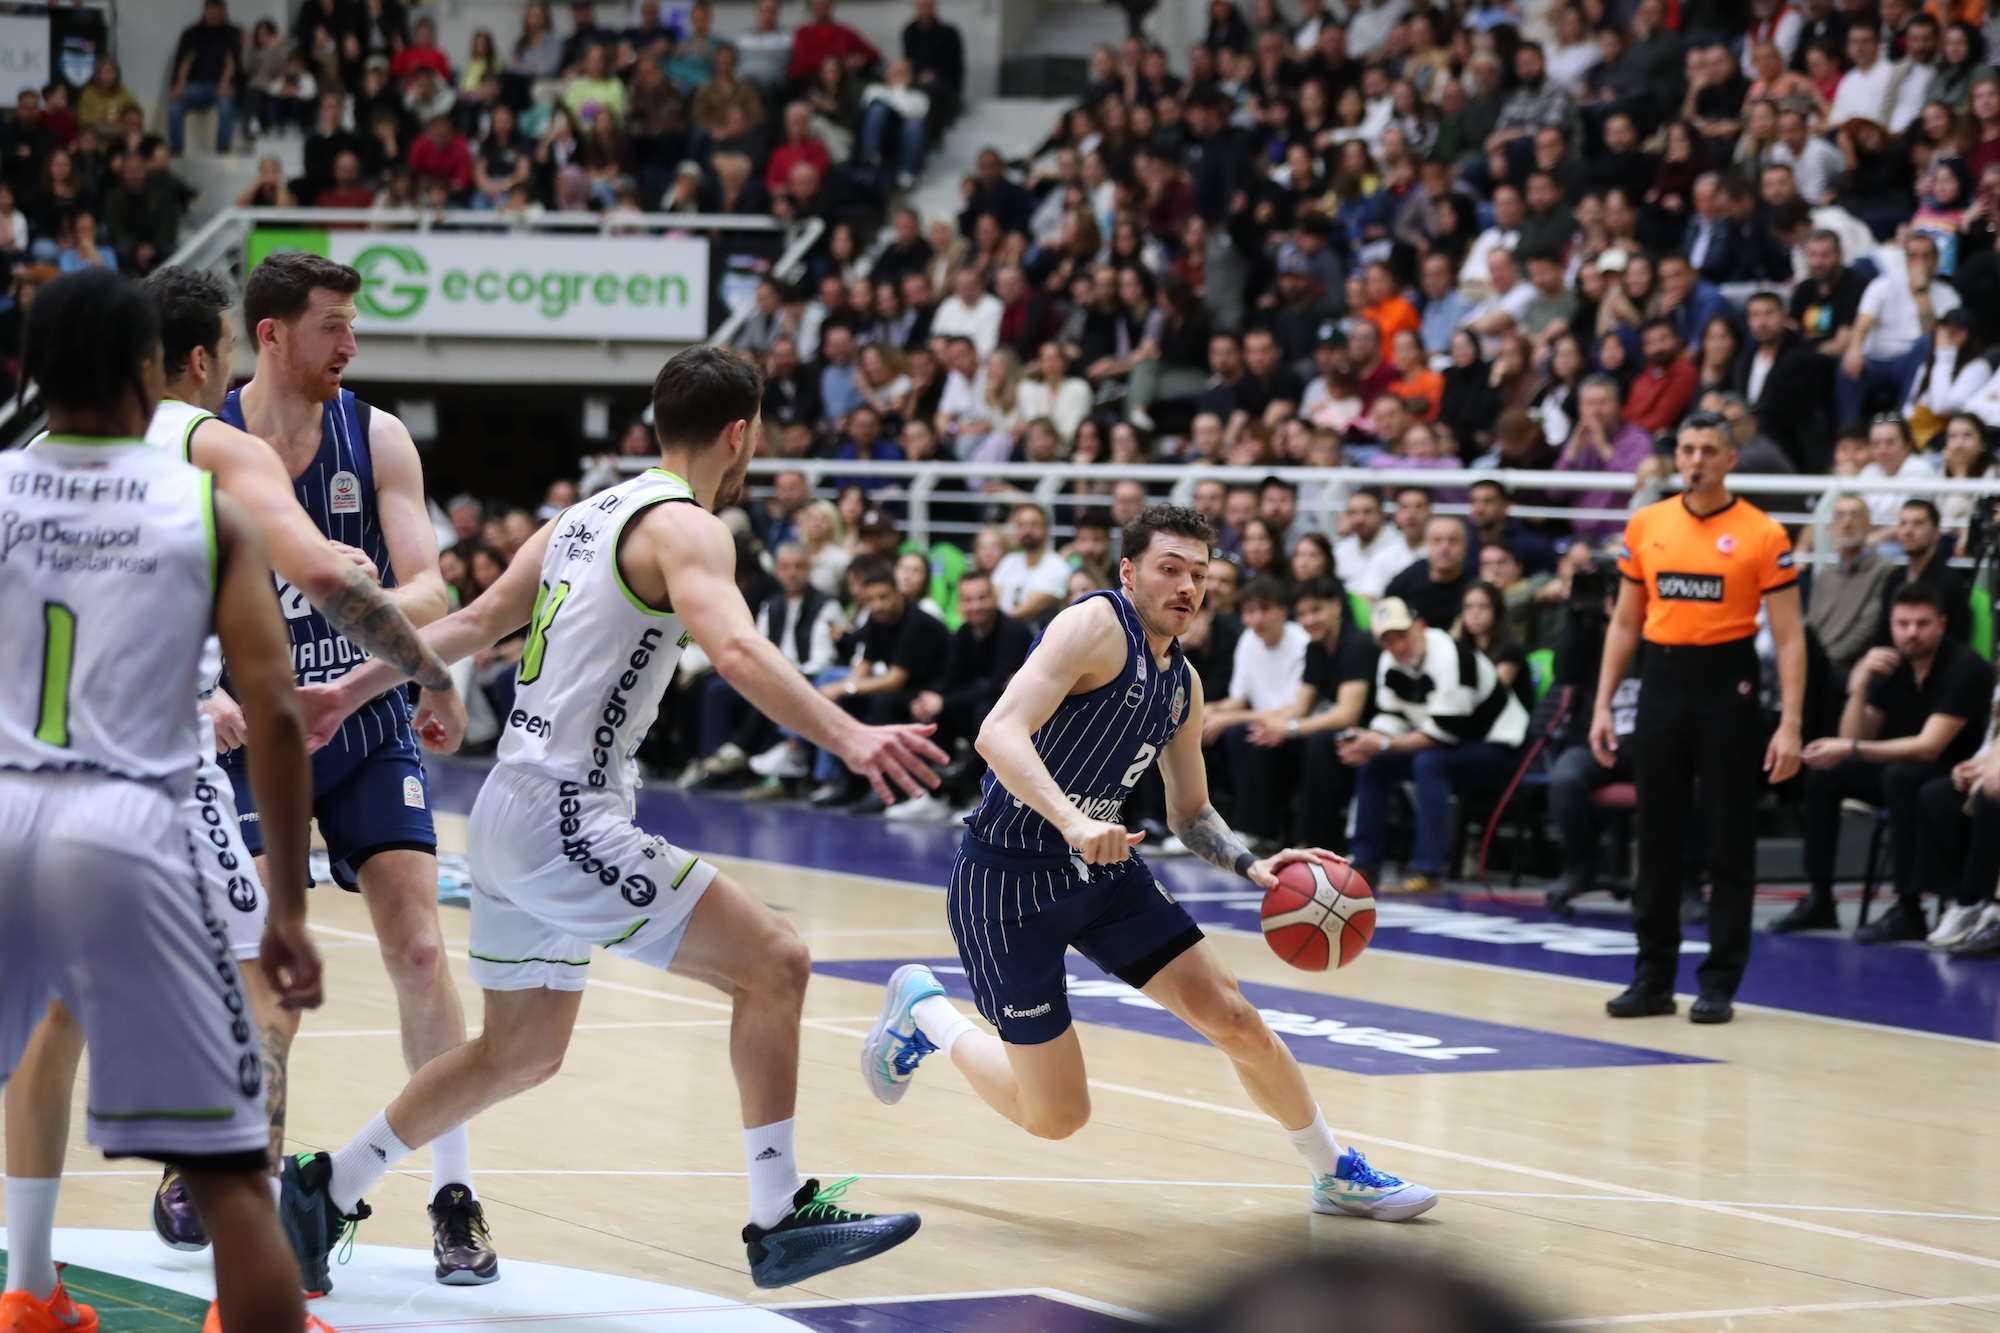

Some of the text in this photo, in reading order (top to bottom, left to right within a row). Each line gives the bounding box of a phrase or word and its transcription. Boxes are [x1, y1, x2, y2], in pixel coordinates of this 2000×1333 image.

[441, 267, 690, 319] ecogreen
[34, 601, 77, 748] 1
[510, 709, 551, 739] een
[588, 628, 663, 788] ecogreen
[1121, 742, 1157, 788] 2
[559, 781, 620, 886] ecogreen
[1012, 1002, 1051, 1018] corendon
